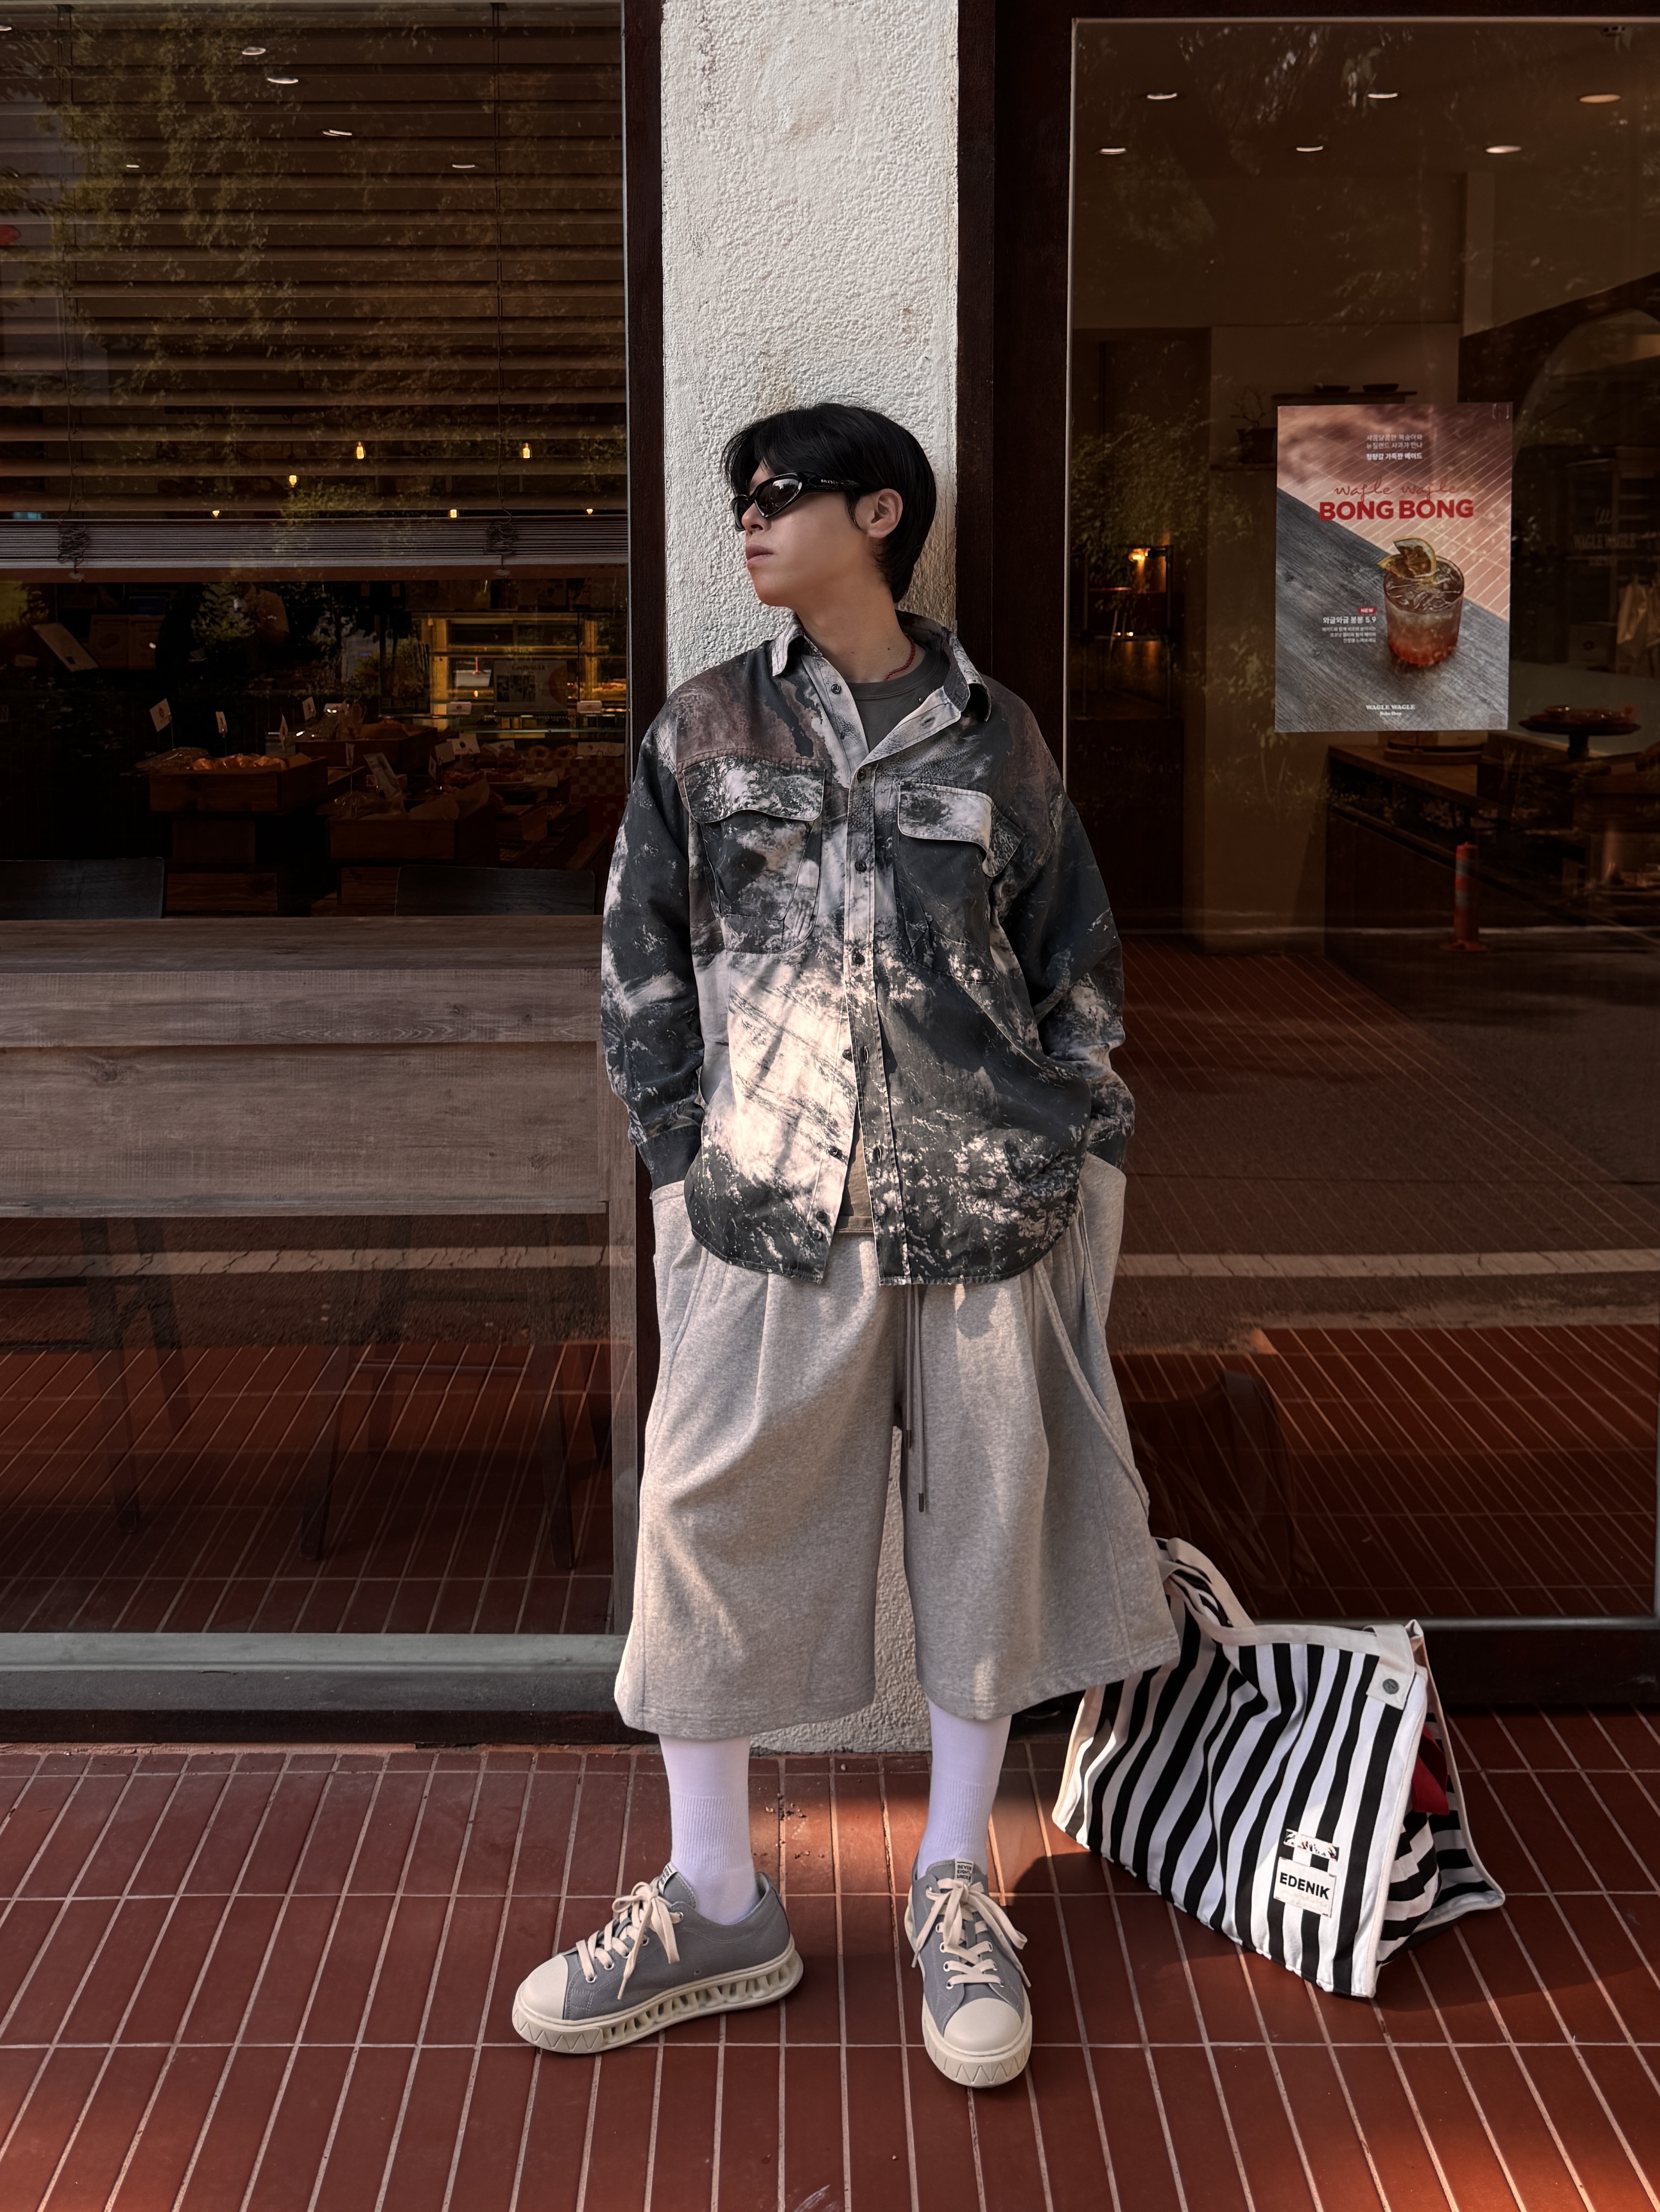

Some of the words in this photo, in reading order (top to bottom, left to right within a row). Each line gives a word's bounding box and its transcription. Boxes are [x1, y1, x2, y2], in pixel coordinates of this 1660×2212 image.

[1319, 500, 1394, 521] BONG
[1399, 499, 1474, 520] BONG
[1279, 1872, 1331, 1900] EDENIK
